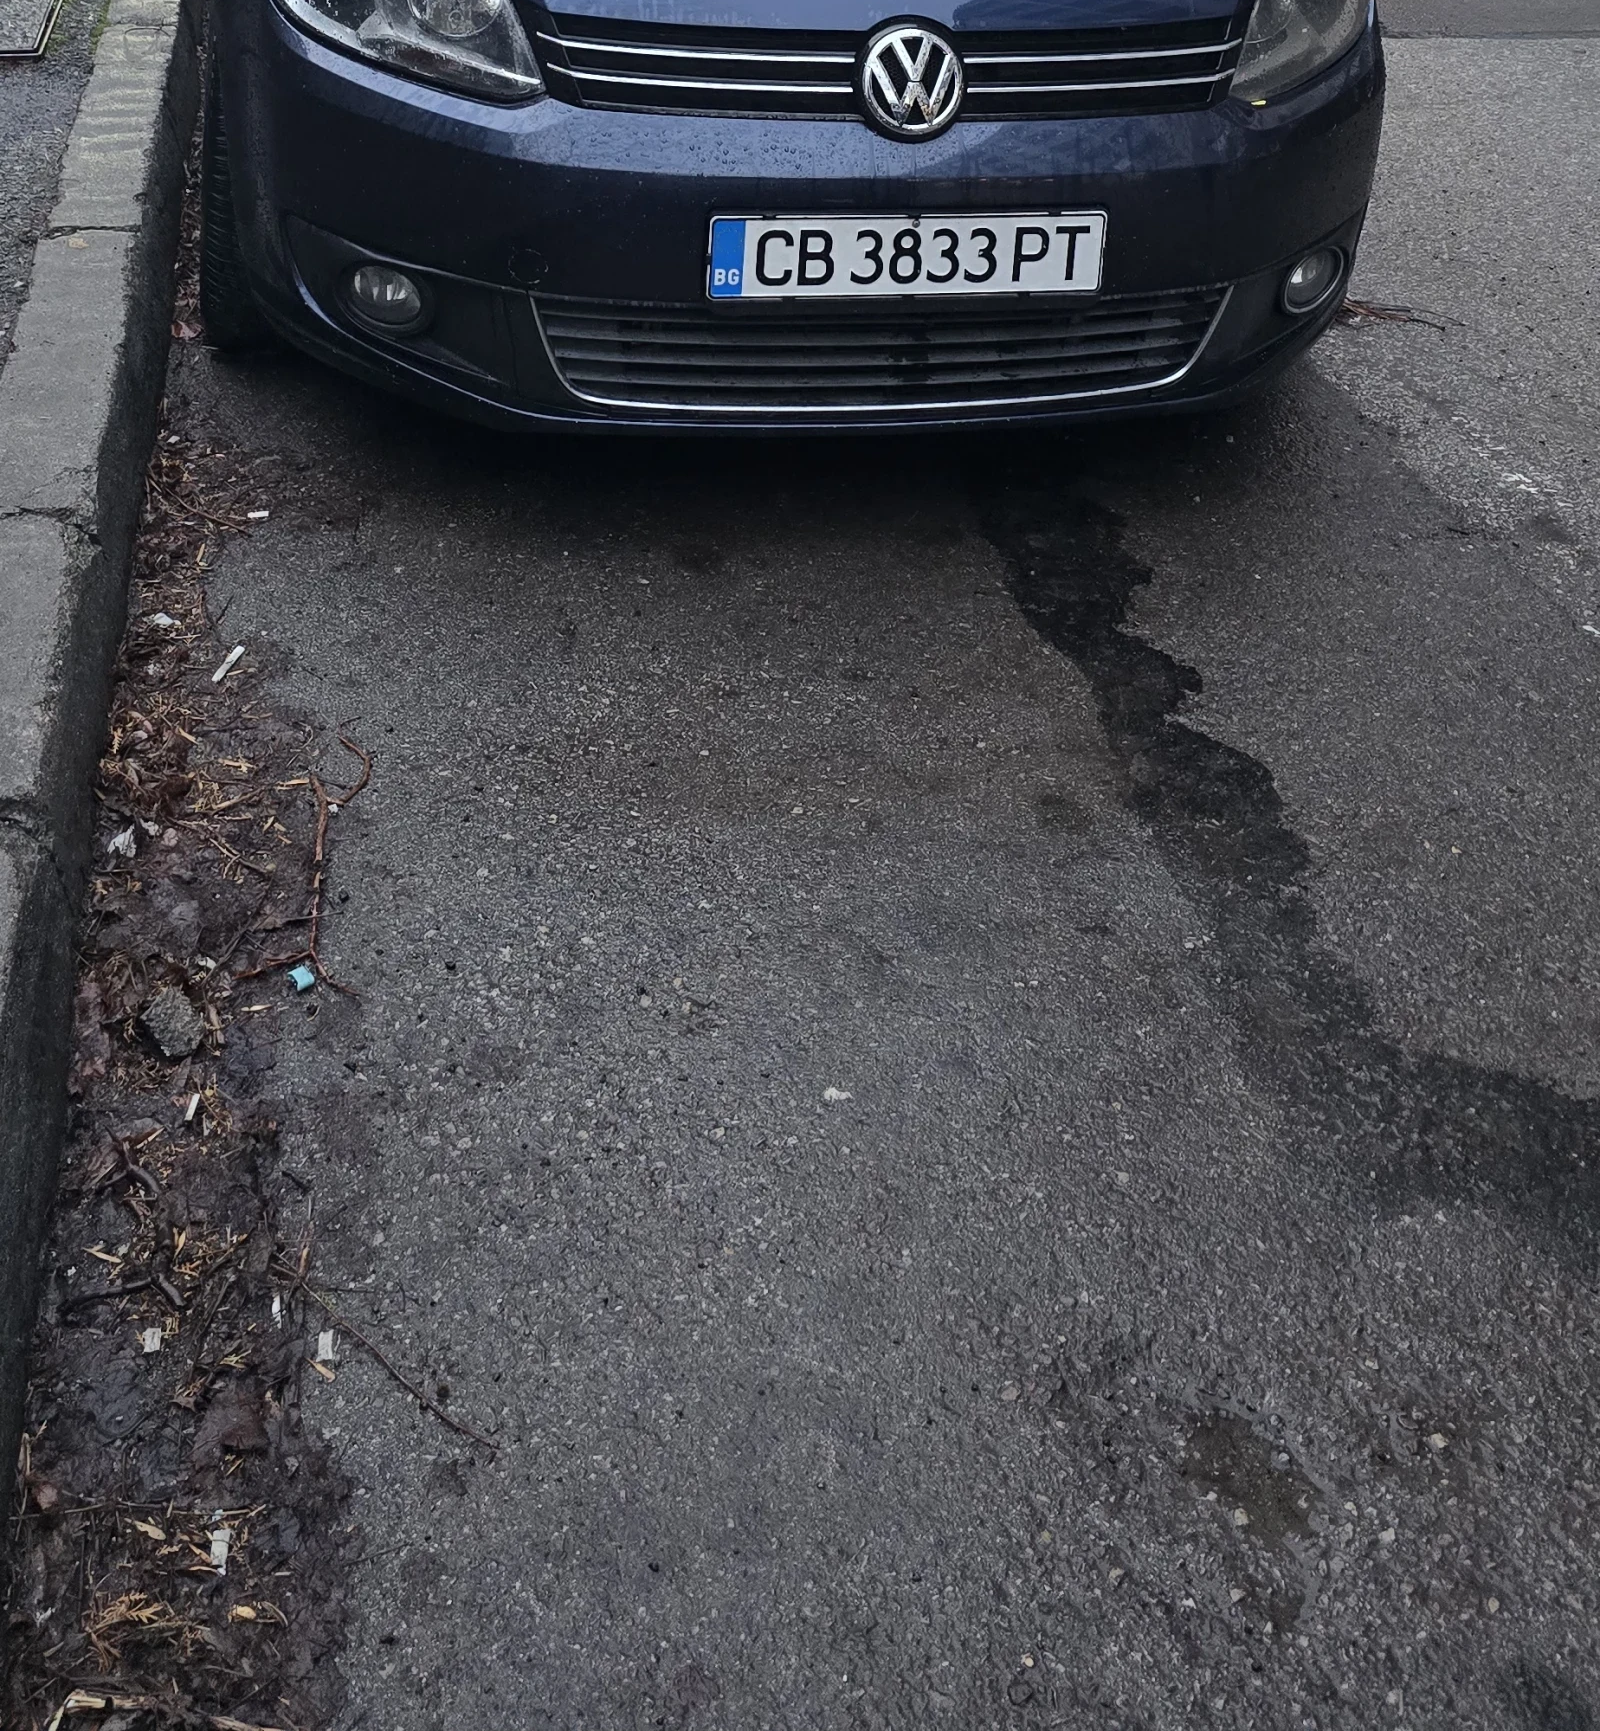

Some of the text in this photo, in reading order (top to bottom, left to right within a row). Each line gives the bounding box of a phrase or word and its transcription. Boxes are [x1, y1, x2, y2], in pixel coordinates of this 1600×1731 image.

[755, 225, 1092, 286] CB 3833 PT
[713, 269, 741, 286] BG
